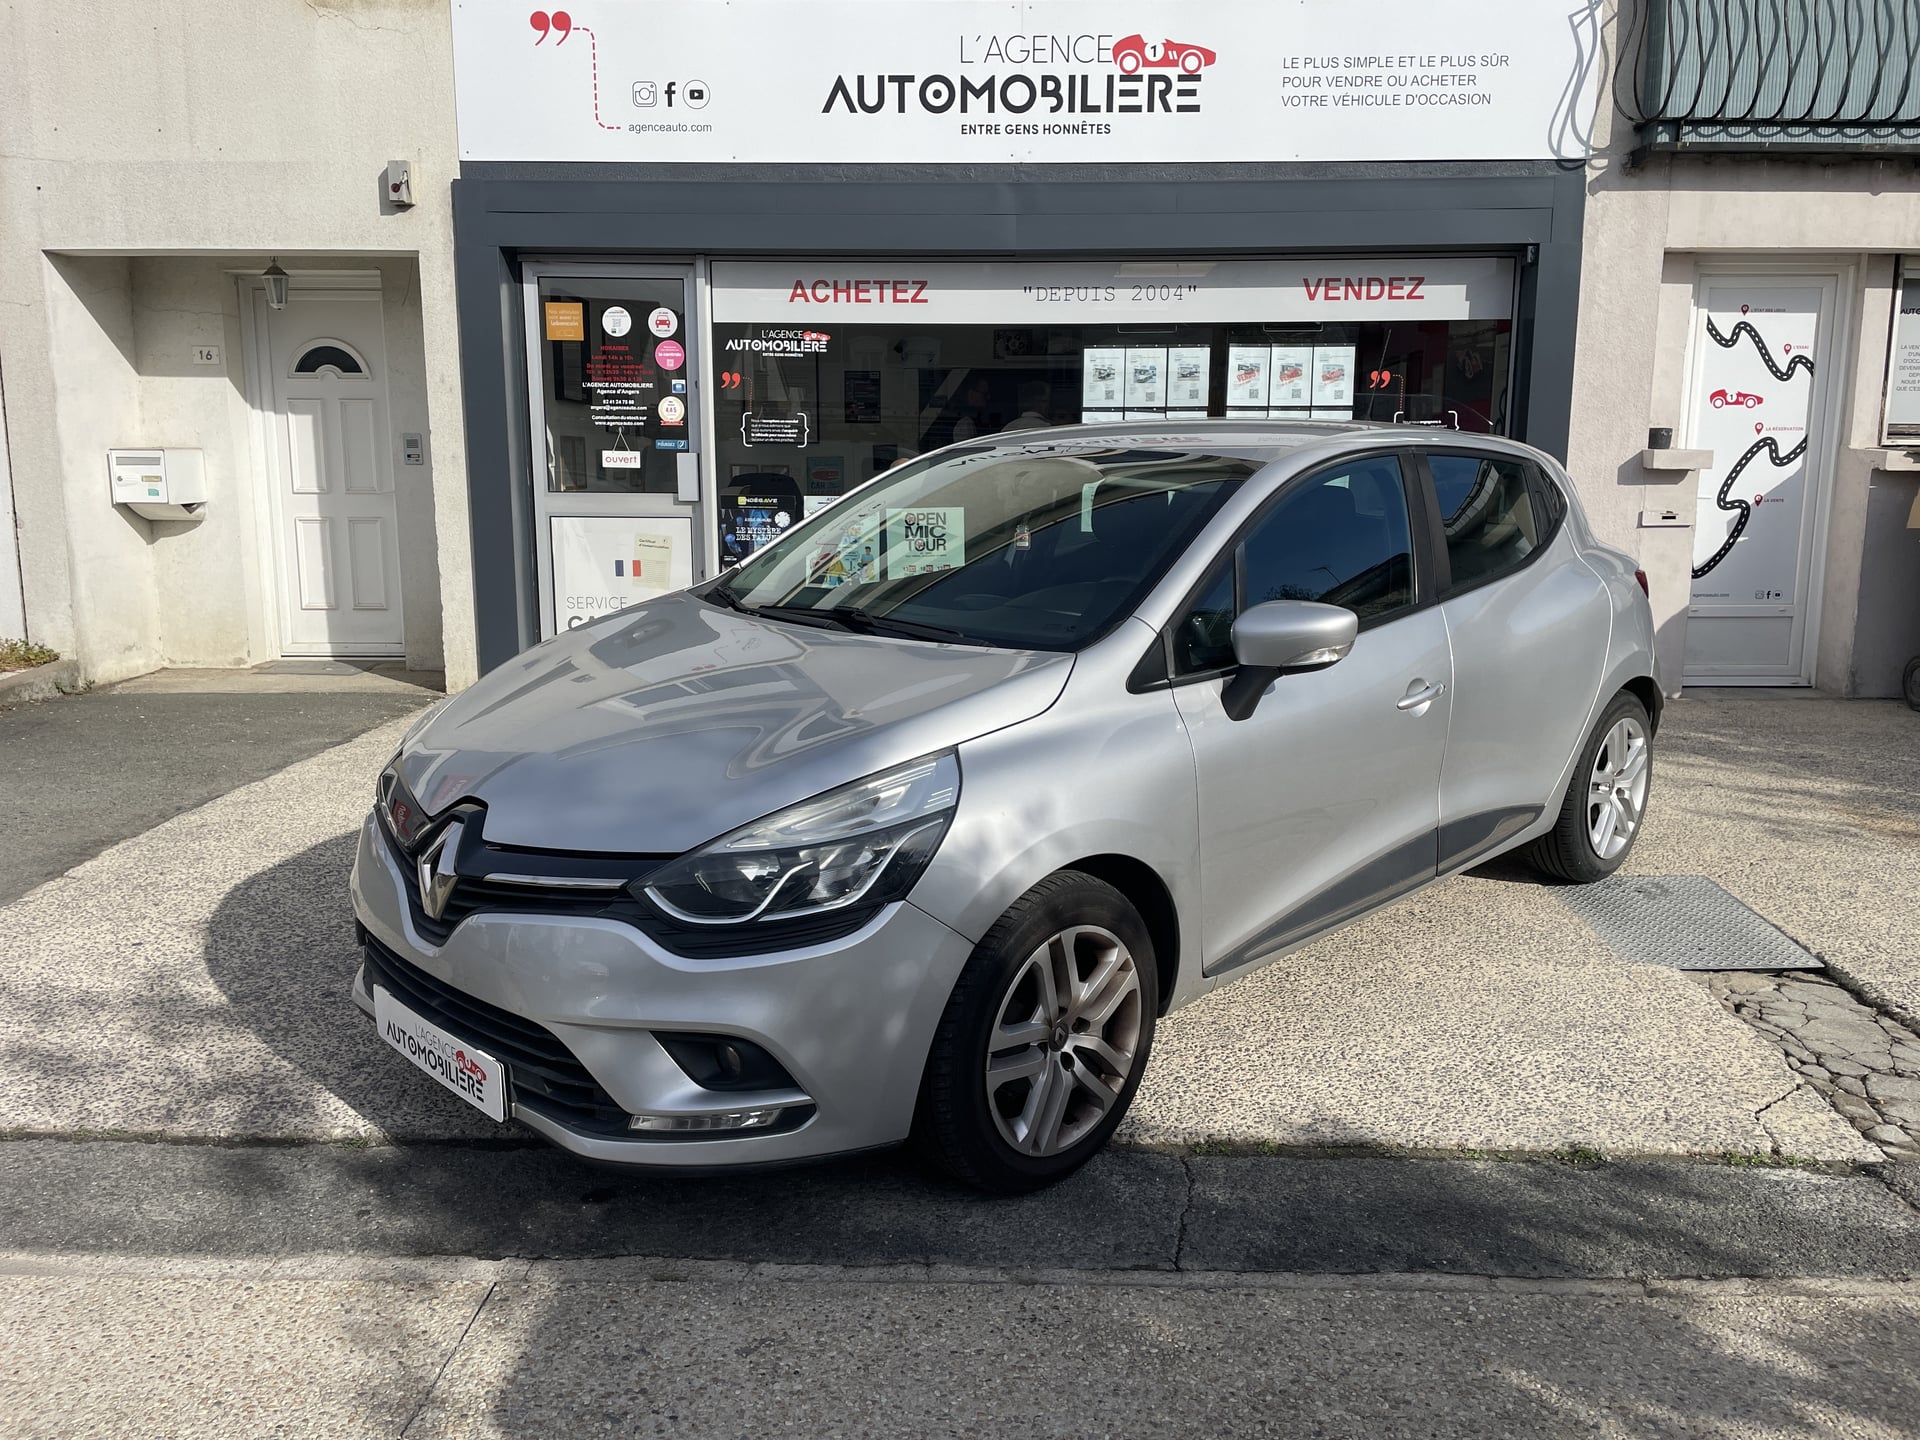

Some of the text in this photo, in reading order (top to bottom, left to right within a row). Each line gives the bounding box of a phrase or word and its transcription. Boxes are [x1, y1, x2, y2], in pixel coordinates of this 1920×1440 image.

[960, 34, 1112, 64] L'AGENCE
[1283, 52, 1509, 69] LE PLUS SIMPLE ET LE PLUS SÛR
[1282, 74, 1477, 88] POUR VENDRE OU ACHETER
[821, 74, 1202, 115] AUTOMOBILIERE
[1281, 92, 1491, 107] VOTRE VÉHICULE D'OCCASION
[628, 121, 712, 134] agenceauto.com
[961, 120, 1111, 135] ENTRE GENS HONNÊTES
[789, 279, 928, 303] ACHETEZ
[1023, 284, 1197, 302] "DEPUIS 2004"
[1303, 276, 1425, 301] VENDEZ
[761, 329, 803, 339] L'AGENCE
[725, 339, 828, 353] AUTOMOBILIERE
[199, 350, 213, 361] 16
[605, 456, 637, 464] ouvert
[904, 511, 947, 526] OPEN
[735, 526, 746, 534] LE
[904, 524, 947, 539] MIC
[904, 538, 947, 552] TOUR
[566, 596, 628, 610] SERVICE
[414, 1023, 456, 1063] L'AGENCE
[386, 1019, 485, 1104] AUTOMOBILIERE
